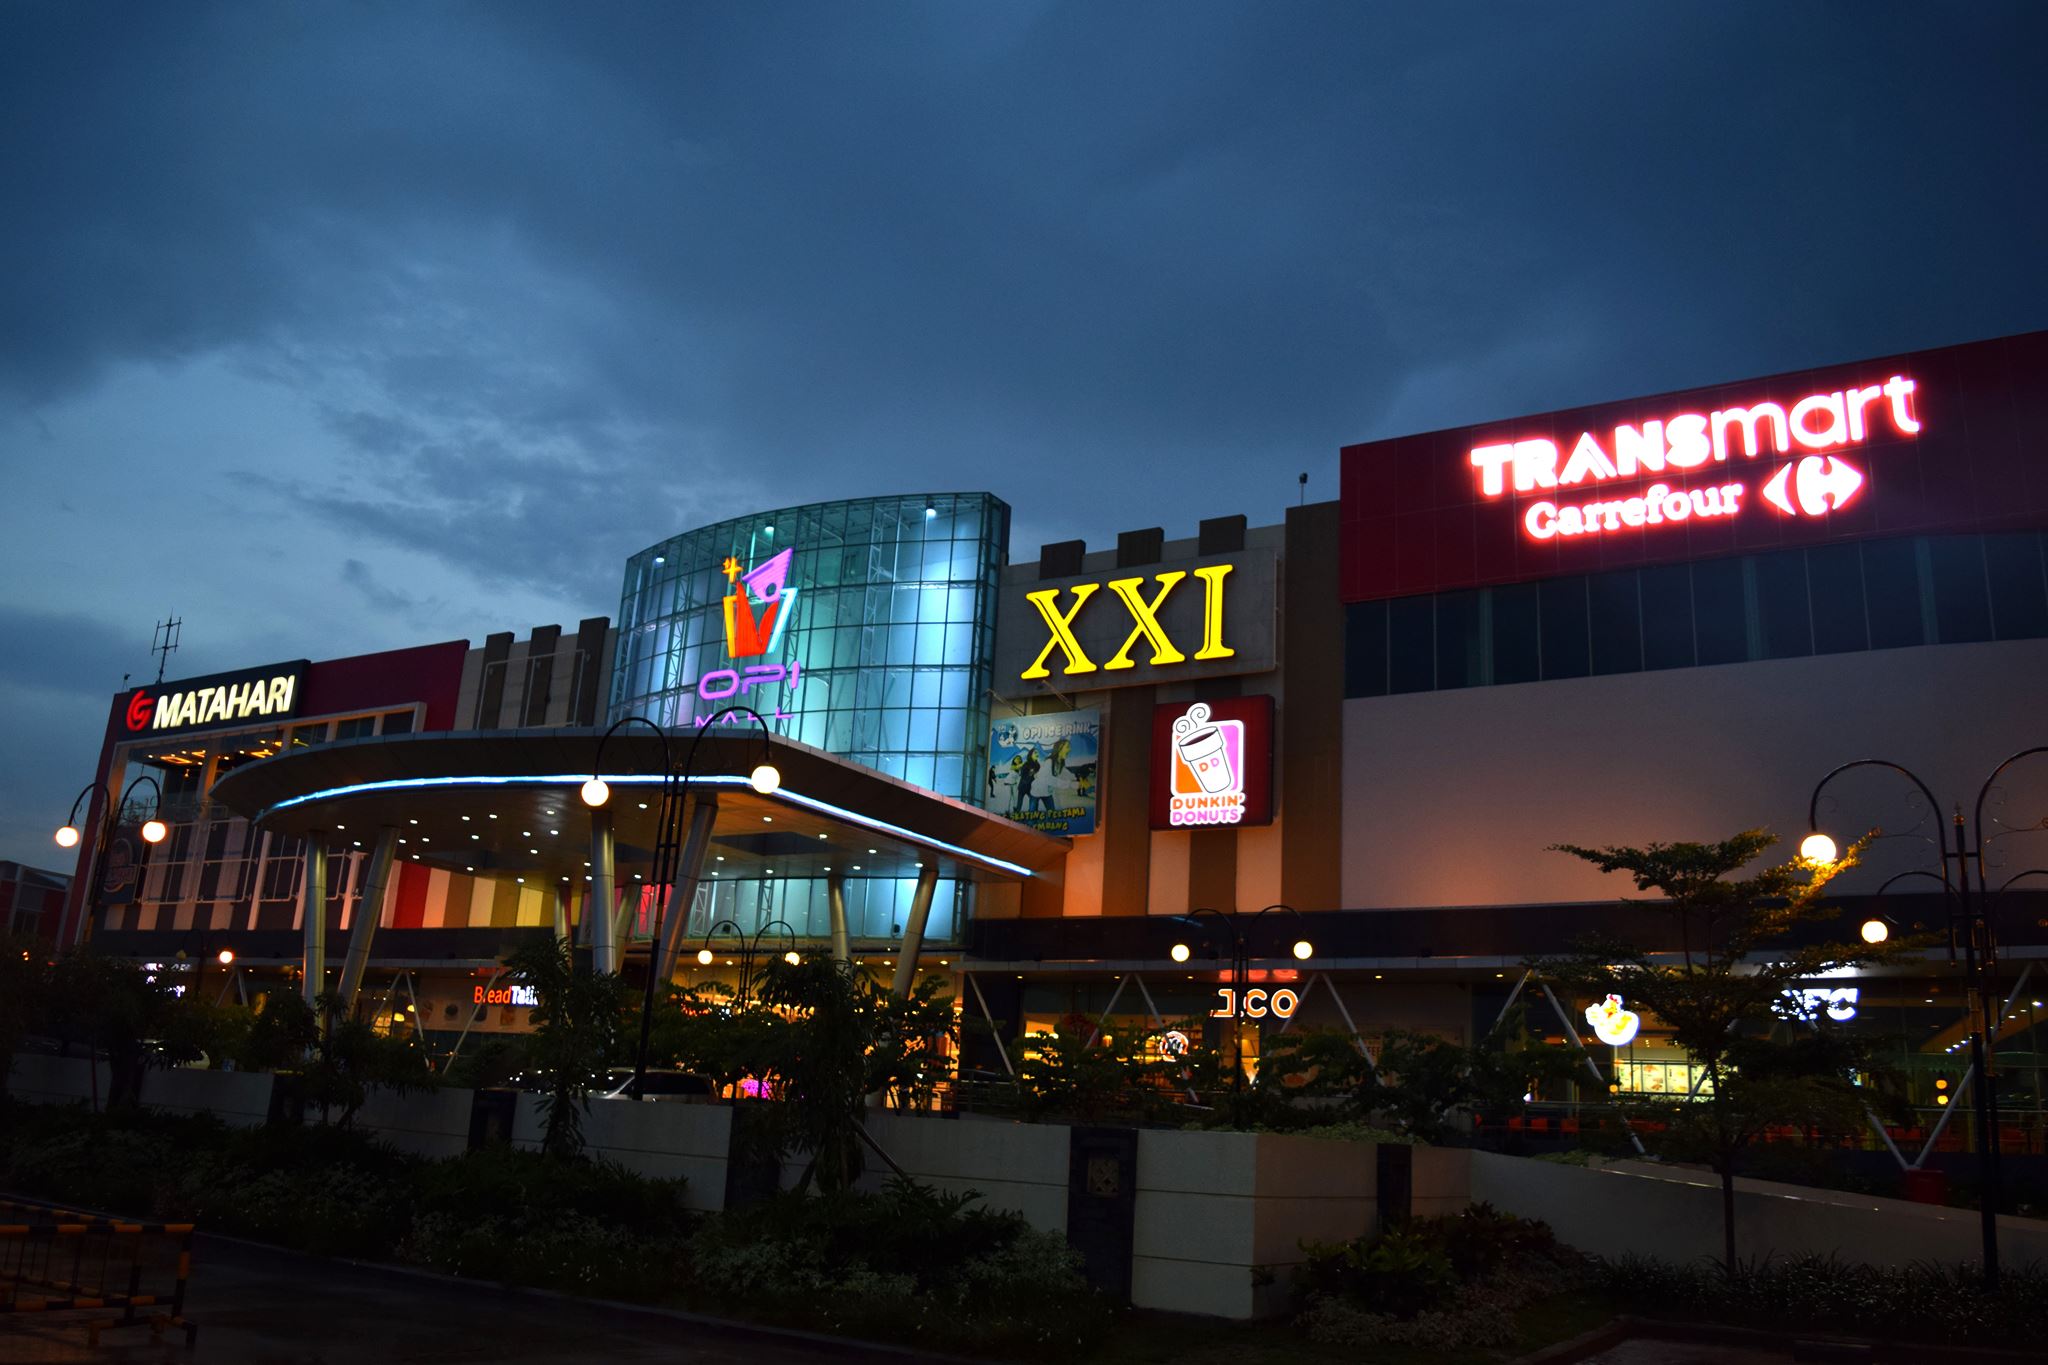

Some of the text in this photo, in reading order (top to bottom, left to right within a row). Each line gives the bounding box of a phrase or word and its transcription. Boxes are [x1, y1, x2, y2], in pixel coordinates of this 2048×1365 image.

[1470, 375, 1920, 497] TRANSmart
[1525, 483, 1744, 539] Carrefour
[1021, 564, 1235, 680] XXI
[152, 675, 296, 730] MATAHARI
[699, 661, 800, 700] OPI
[1023, 728, 1041, 740] OPI
[1043, 725, 1061, 737] ICE
[1172, 795, 1243, 810] DUNKIN'
[1172, 809, 1239, 823] DONUTS
